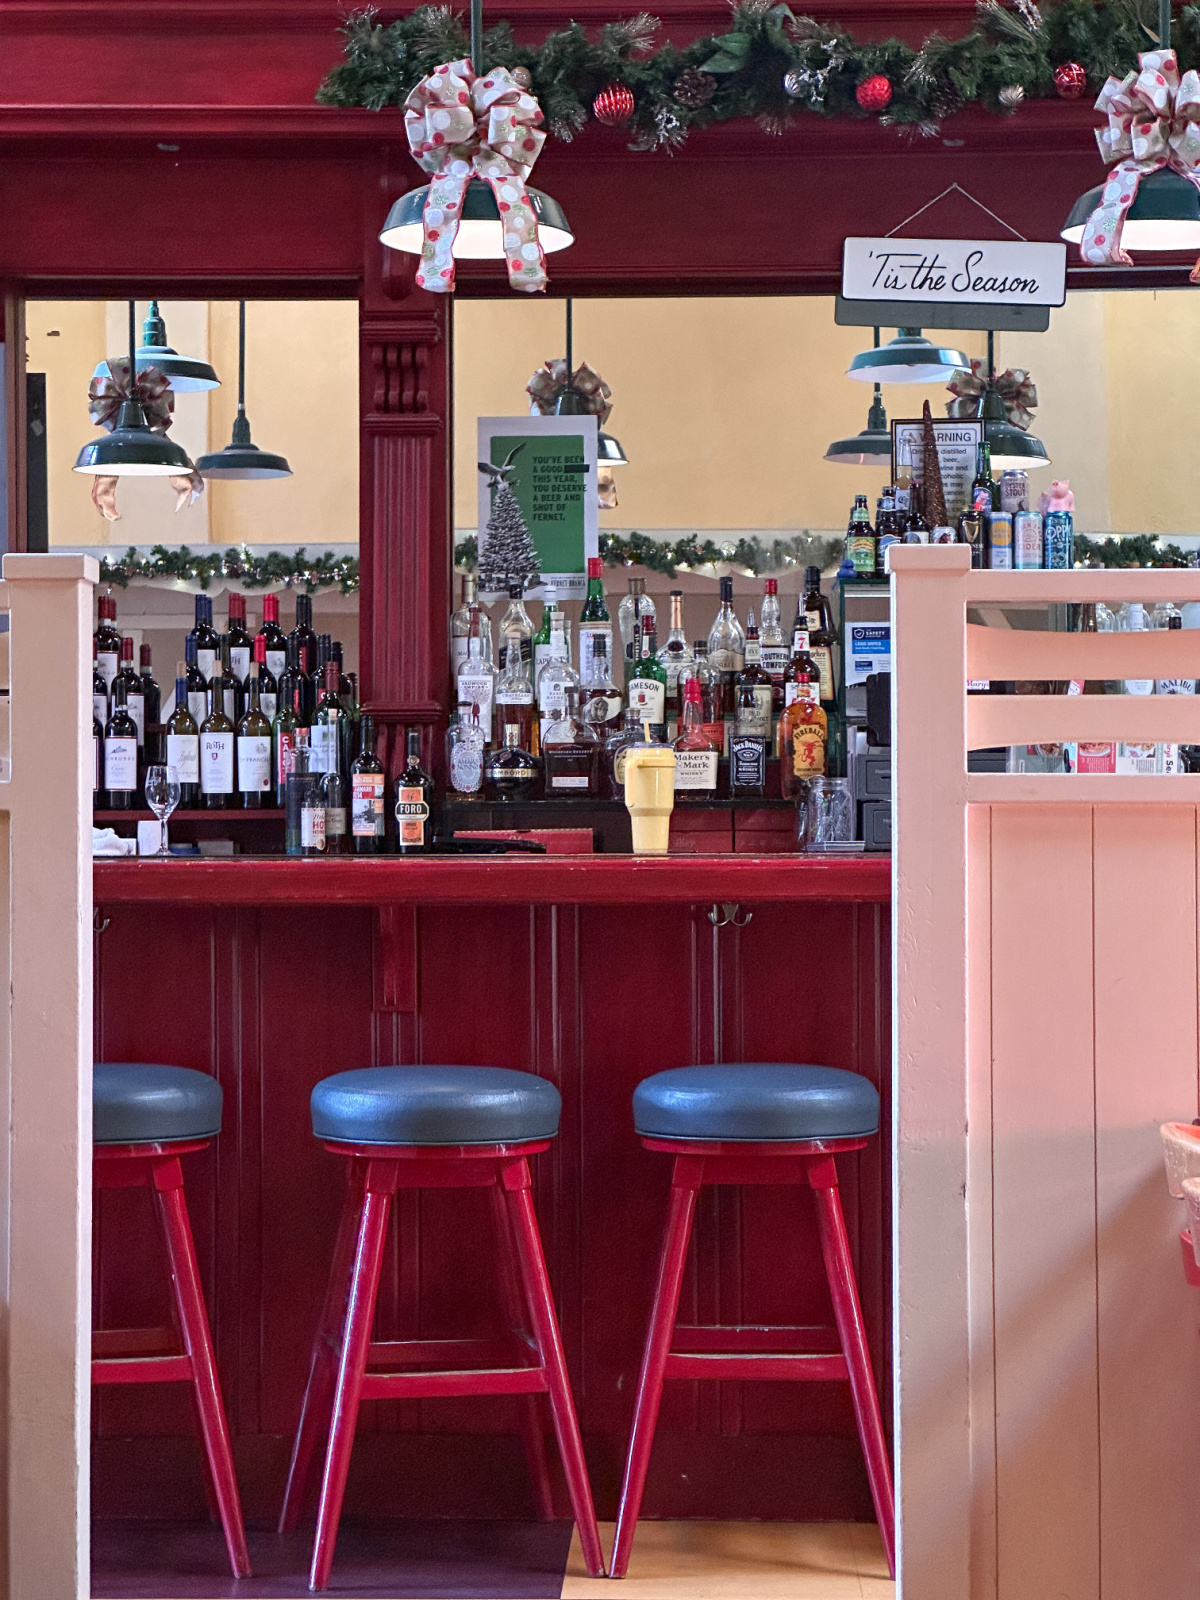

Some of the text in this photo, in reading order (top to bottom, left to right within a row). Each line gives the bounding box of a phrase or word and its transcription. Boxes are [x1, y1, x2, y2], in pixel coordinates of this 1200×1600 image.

[869, 250, 1040, 294] 'Tis the Season
[532, 456, 584, 464] YOU'VE BEEN
[533, 465, 563, 473] A GOOD
[554, 475, 577, 483] YEAR,
[533, 484, 587, 492] YOU DESERVE
[1005, 488, 1026, 497] STOUT
[533, 503, 553, 511] SHOT
[533, 513, 566, 521] FERNET.
[798, 637, 805, 649] 7
[1161, 680, 1192, 692] MALIBU
[206, 741, 224, 750] ROTH
[732, 742, 745, 752] JACK
[400, 804, 422, 814] FORO
